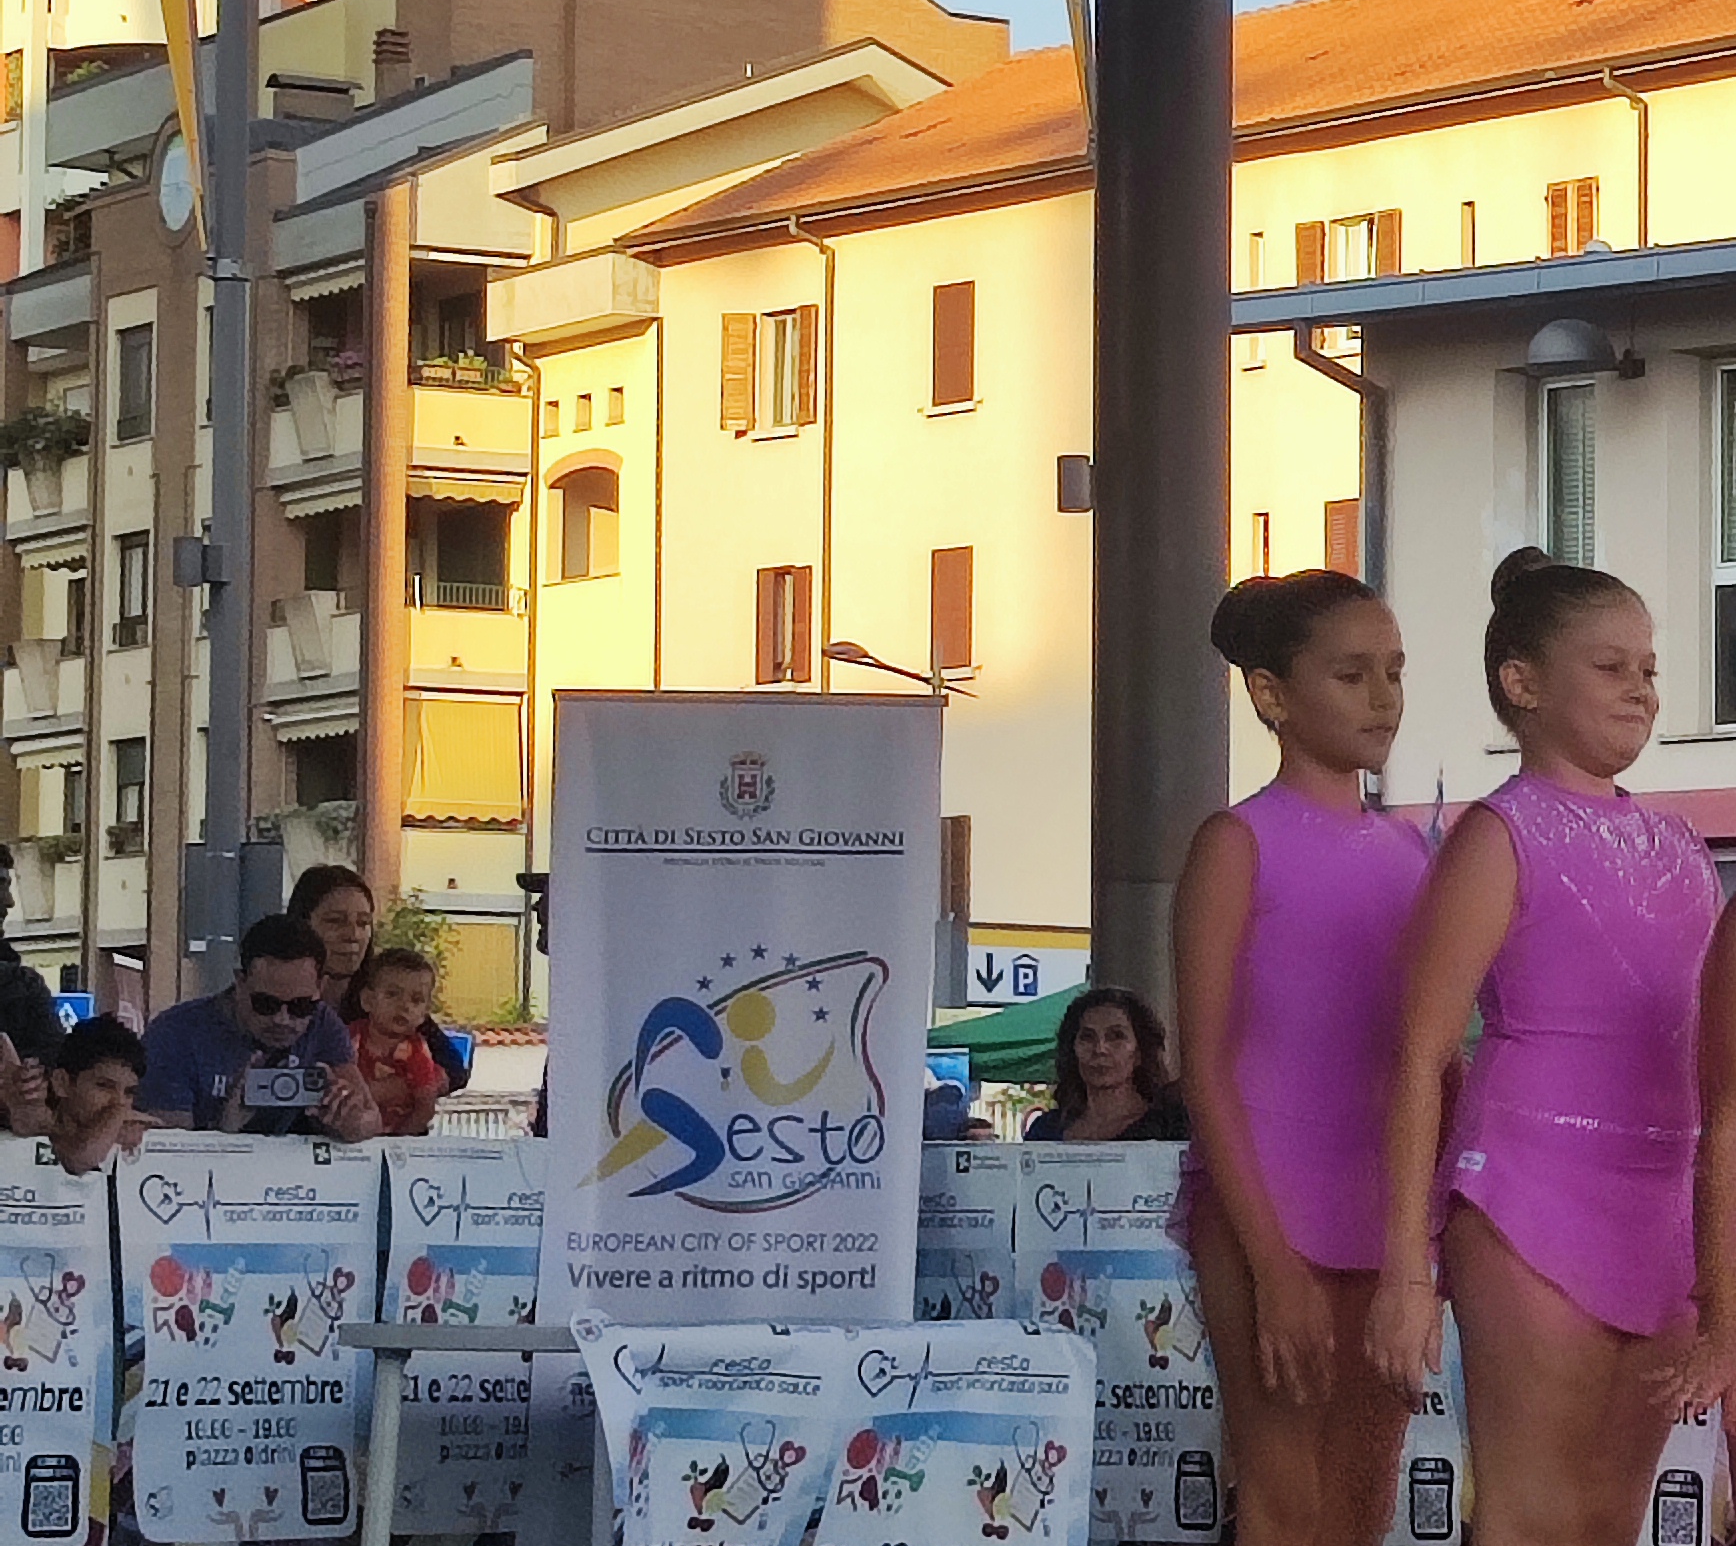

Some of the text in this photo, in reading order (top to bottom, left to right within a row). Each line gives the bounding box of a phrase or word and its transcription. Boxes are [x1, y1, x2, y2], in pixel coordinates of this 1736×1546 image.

[586, 824, 905, 847] CITTÀ DI SESTO SAN GIOVANNI
[566, 1231, 879, 1253] EUROPEAN CITY OF SPORT 2022
[566, 1262, 877, 1295] Vivere a ritmo di sport!
[144, 1374, 344, 1408] 21 e 22 settembre
[427, 1377, 442, 1401] e
[447, 1373, 474, 1403] 22
[1110, 1379, 1215, 1410] settembre
